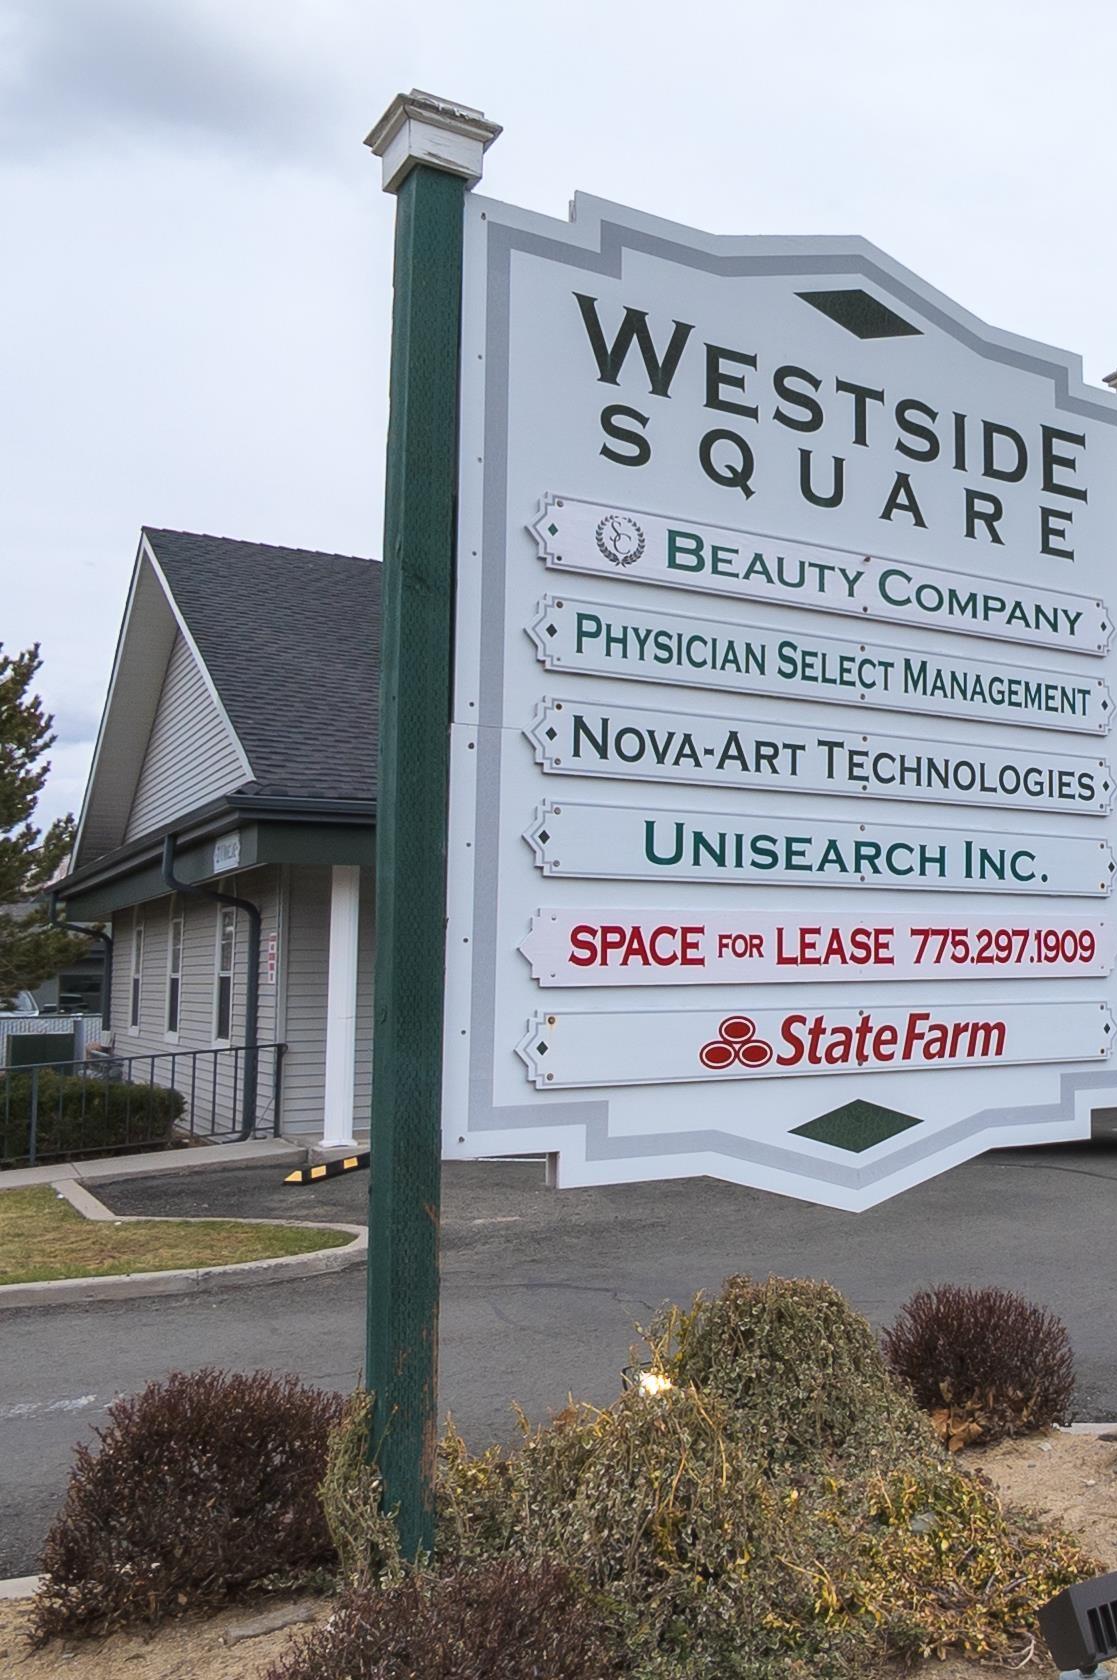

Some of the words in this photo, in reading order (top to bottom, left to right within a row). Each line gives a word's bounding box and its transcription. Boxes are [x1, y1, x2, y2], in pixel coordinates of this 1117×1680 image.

[571, 290, 1088, 503] WESTSIDE
[599, 403, 1076, 562] SQUARE
[665, 528, 863, 600] BEAUTY
[877, 568, 1084, 637] COMPANY
[574, 612, 768, 677] PHYSICIAN
[776, 640, 895, 692] SELECT
[903, 658, 1092, 718] MANAGEMENT
[571, 715, 807, 778] NOVA-ART
[816, 739, 1097, 802] TECHNOLOGIES
[643, 820, 948, 880] UNISEARCH
[963, 840, 1050, 884] INC.
[567, 923, 706, 967] SPACE
[717, 933, 765, 960] FOR
[774, 926, 895, 966] LEASE
[908, 927, 1096, 965] 775.297.1909
